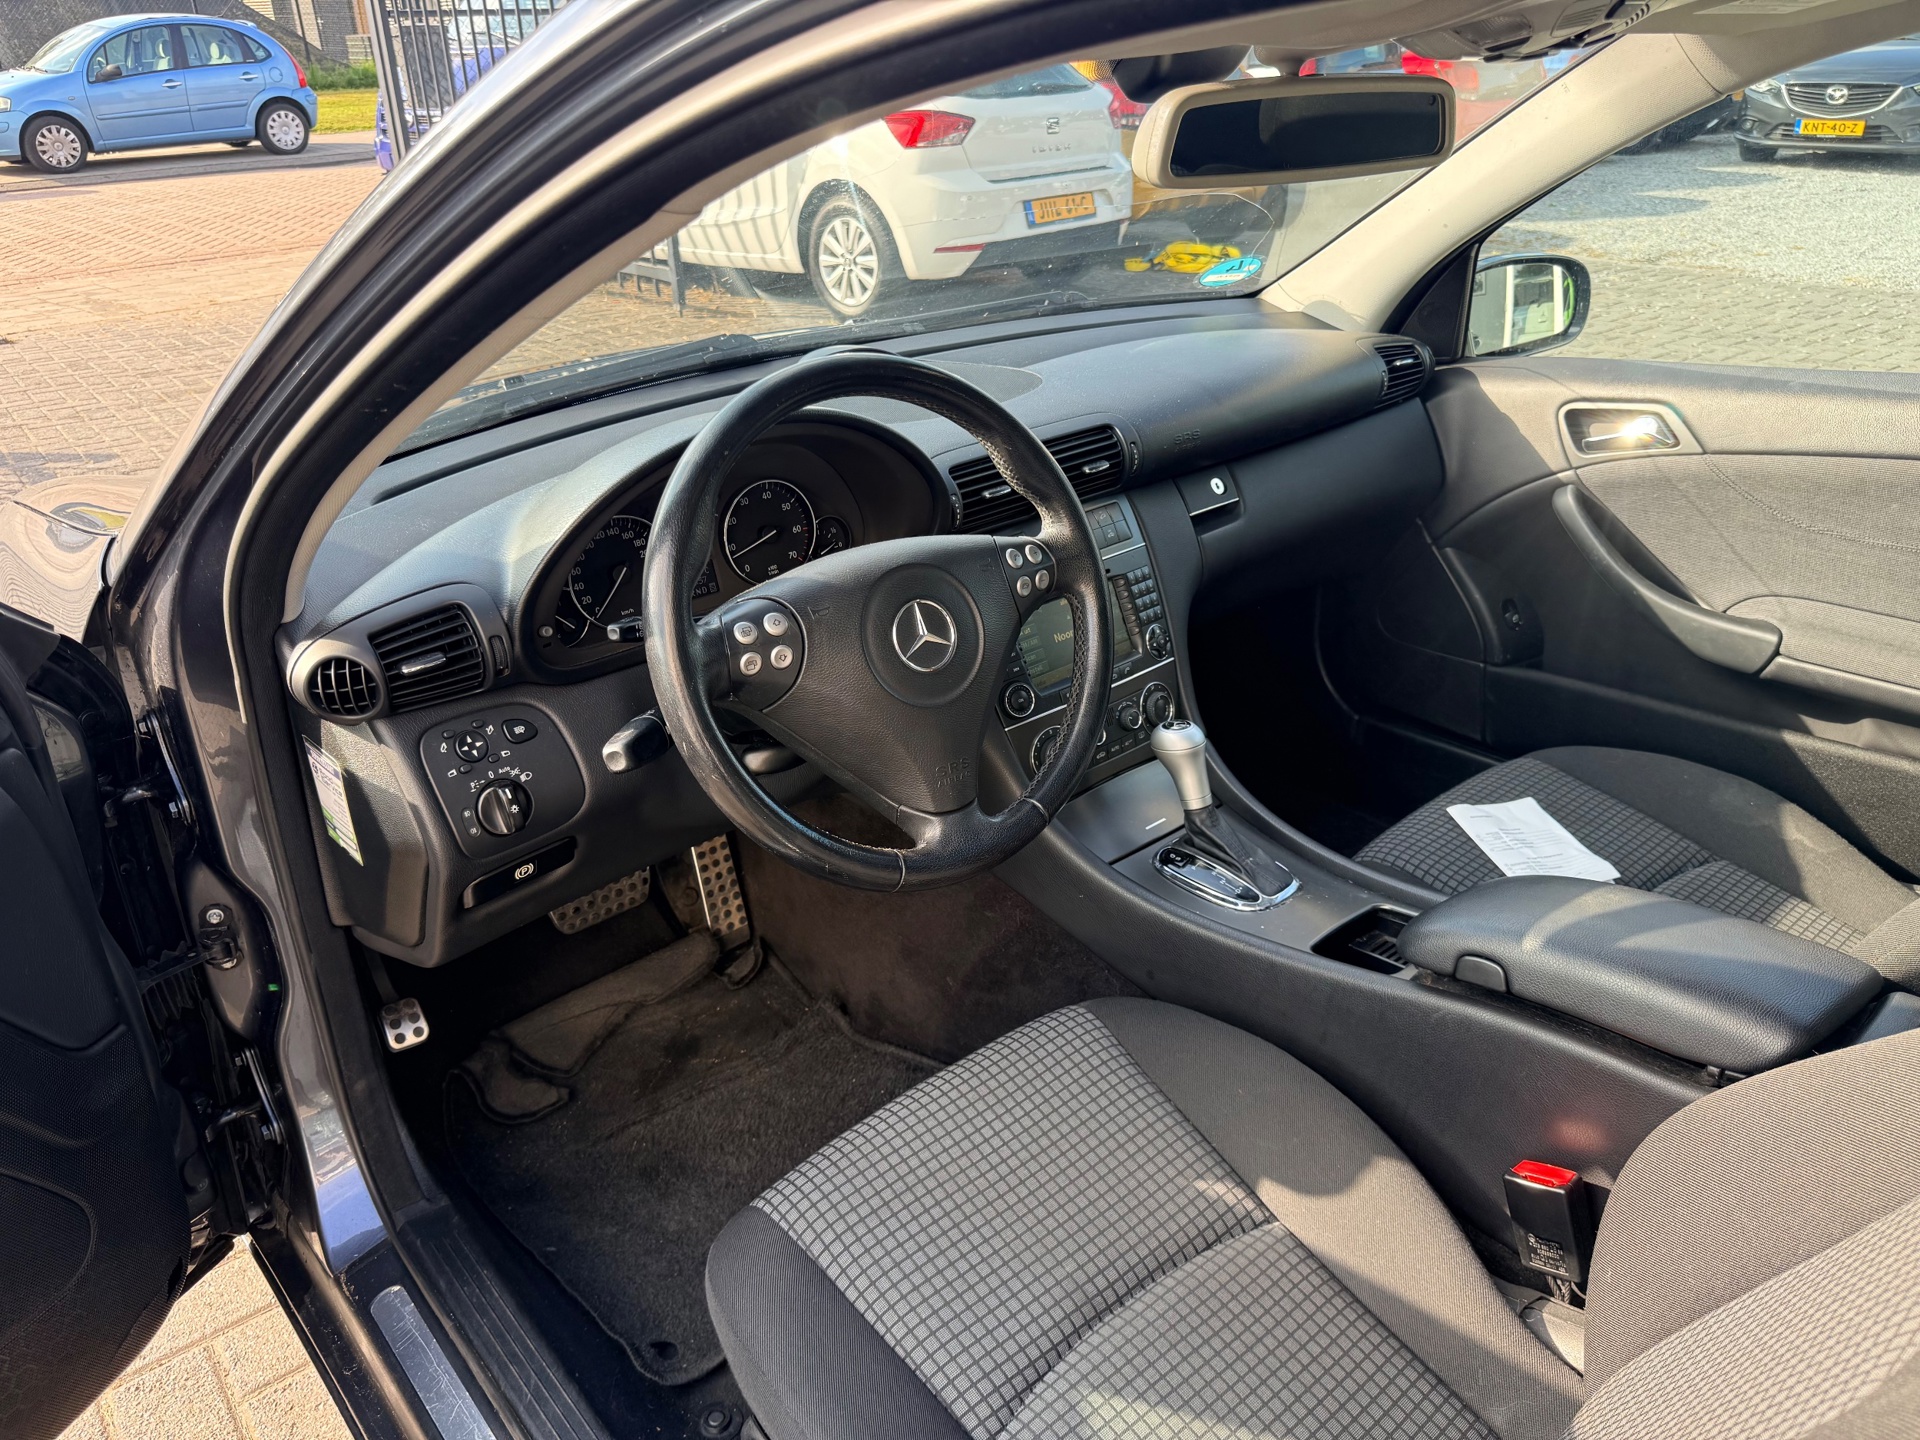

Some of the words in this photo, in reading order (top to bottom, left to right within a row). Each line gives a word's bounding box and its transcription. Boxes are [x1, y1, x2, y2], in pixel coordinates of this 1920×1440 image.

[1803, 122, 1858, 133] KNT-40-Z
[762, 491, 772, 500] 40
[740, 498, 749, 506] 30
[781, 502, 791, 511] 50
[606, 527, 620, 536] 140
[792, 525, 801, 534] 60
[621, 530, 634, 540] 160
[633, 538, 646, 548] 180
[788, 550, 798, 559] 70
[571, 566, 582, 576] 60
[573, 582, 585, 591] 40
[581, 595, 592, 605] 20
